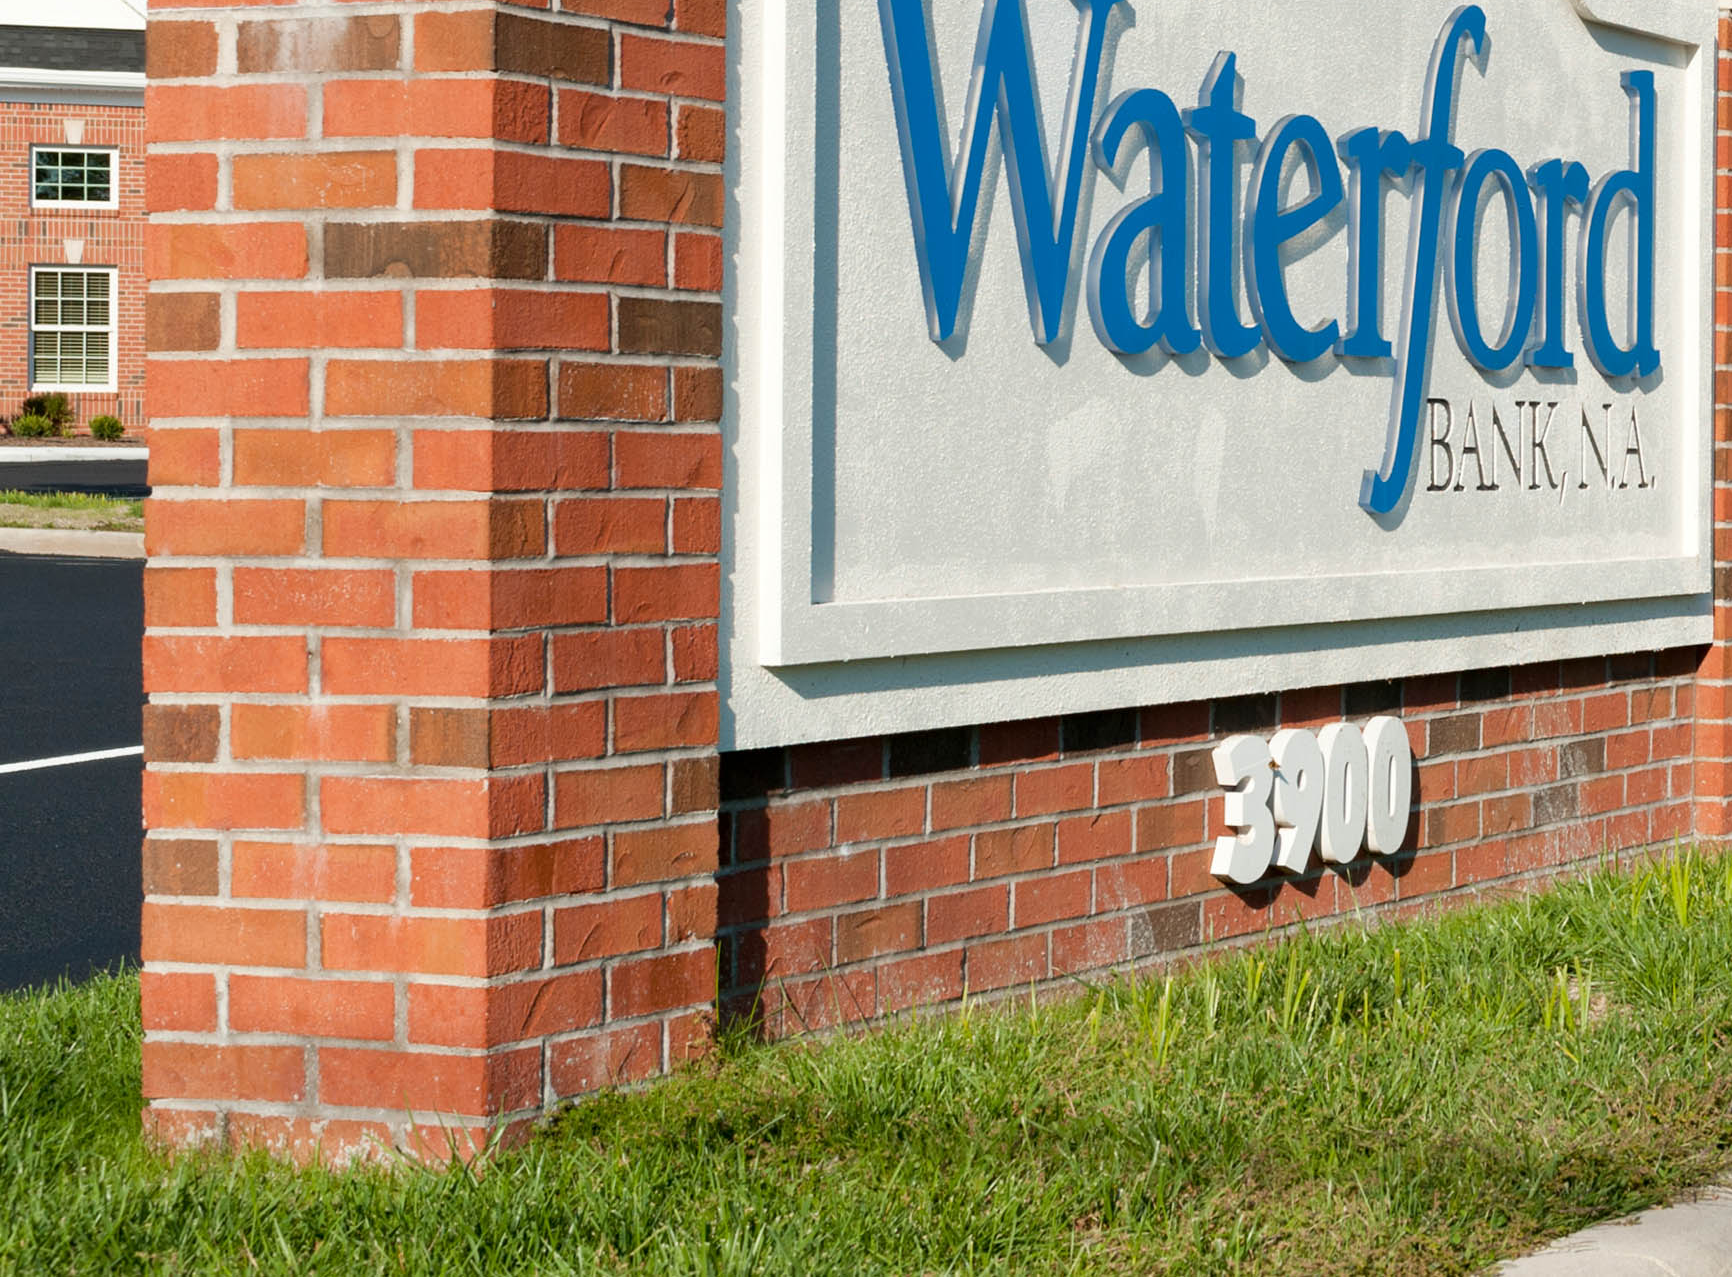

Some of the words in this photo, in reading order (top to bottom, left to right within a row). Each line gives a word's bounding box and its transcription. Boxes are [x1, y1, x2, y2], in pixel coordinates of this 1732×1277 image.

[1426, 398, 1569, 505] BANK,
[1578, 403, 1657, 491] N.A.
[1210, 715, 1412, 884] 3900
